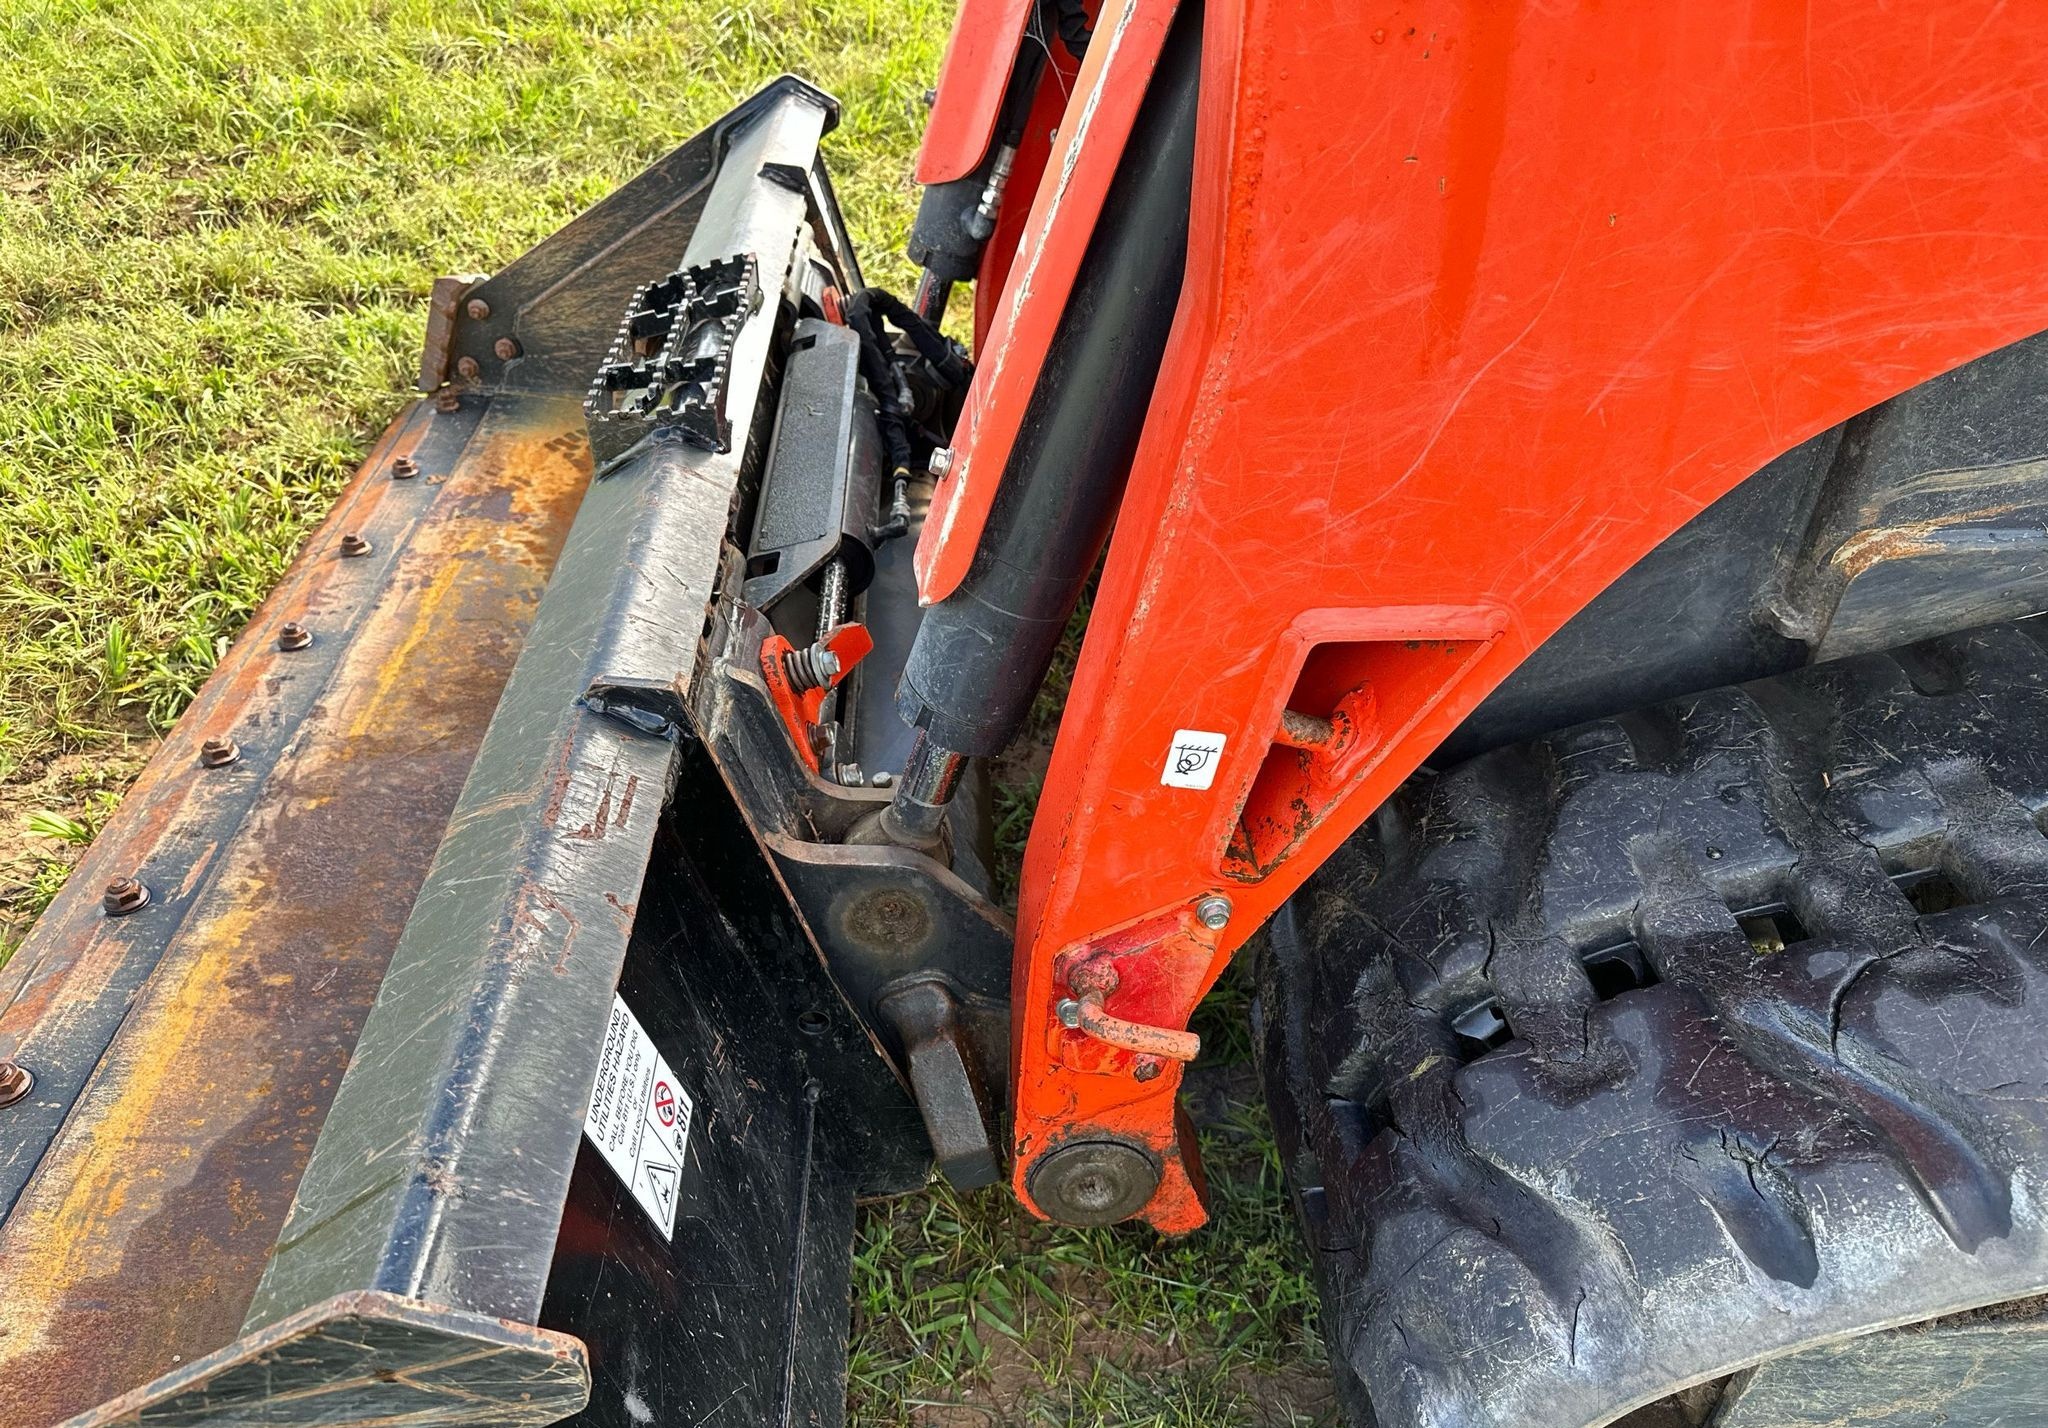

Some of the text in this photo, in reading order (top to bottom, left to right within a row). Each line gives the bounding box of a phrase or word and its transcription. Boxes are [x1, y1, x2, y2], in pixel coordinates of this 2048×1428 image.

[590, 1008, 620, 1123] UNDERGROUND
[597, 1013, 629, 1141] UTILITIES HAZARD
[609, 1030, 638, 1152] CALL BEFORE YOU DIG
[633, 1096, 637, 1110] or
[618, 1122, 626, 1145] Call
[629, 1067, 651, 1158] Call Local Utilities
[677, 1096, 689, 1132] 811
